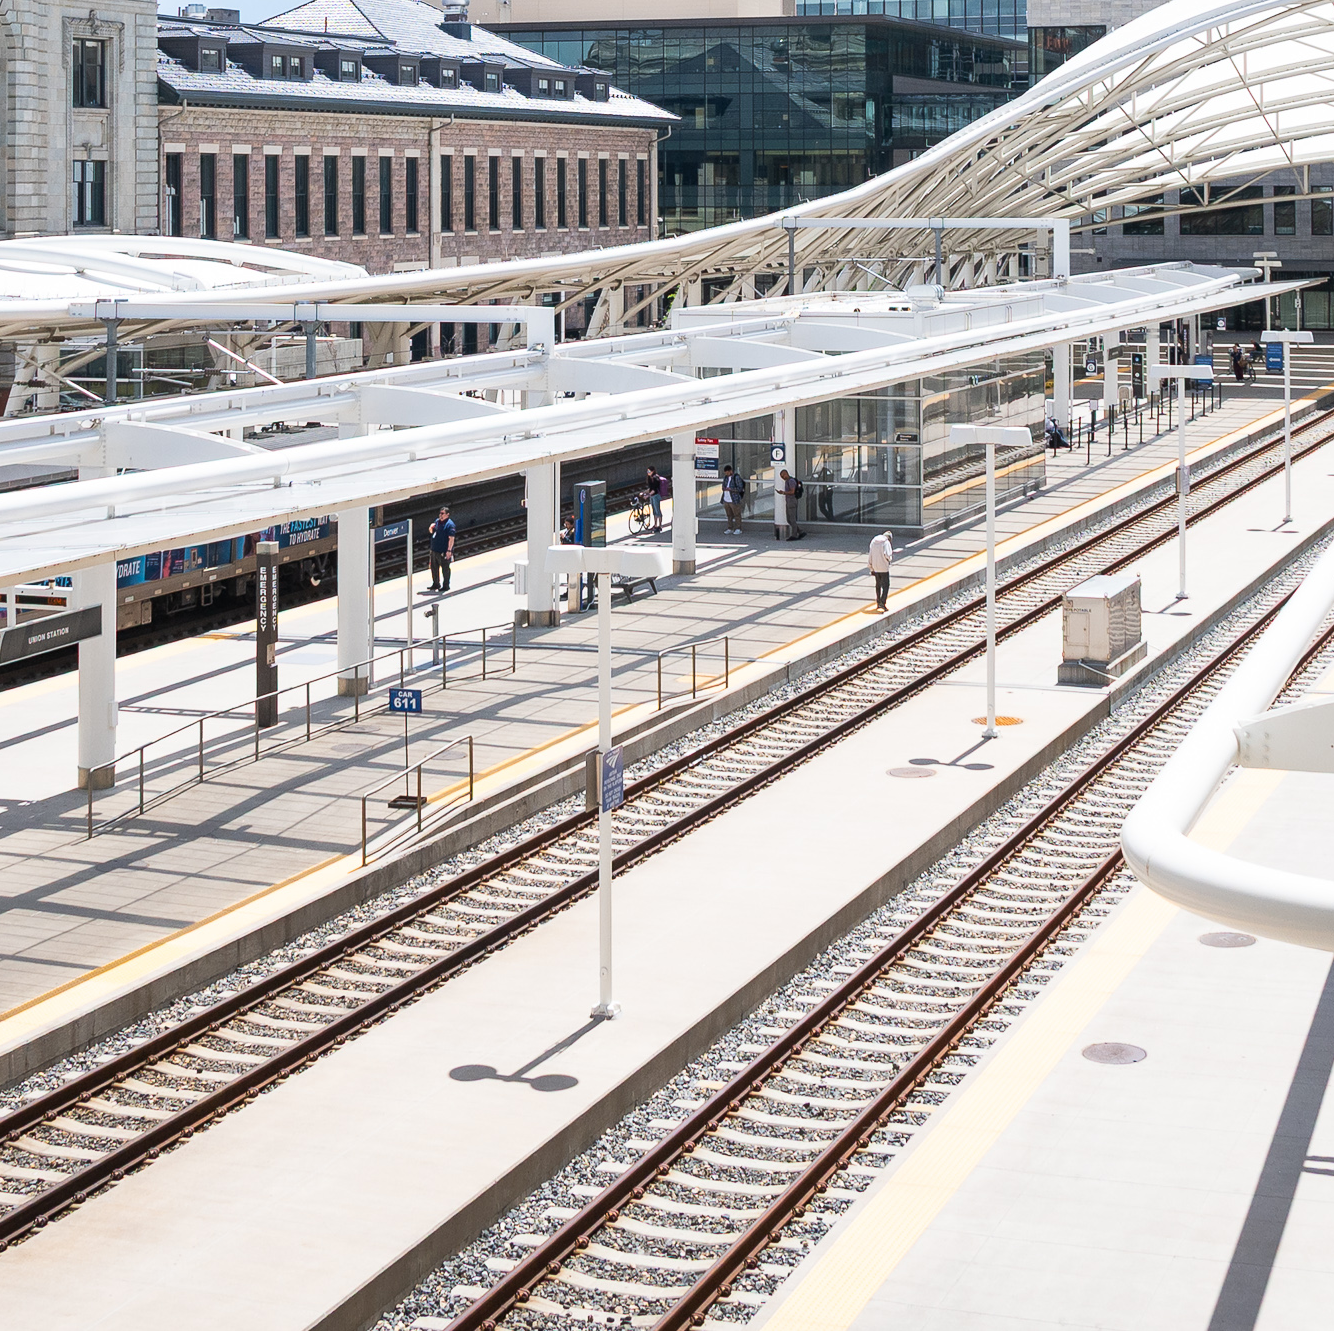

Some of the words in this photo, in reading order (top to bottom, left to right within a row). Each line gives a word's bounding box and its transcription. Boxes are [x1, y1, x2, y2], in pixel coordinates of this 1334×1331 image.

[383, 527, 399, 538] Denver
[289, 534, 297, 546] TO
[28, 632, 46, 645] UNION
[46, 627, 69, 640] STATION
[398, 690, 413, 698] CAR
[393, 697, 417, 710] 611
